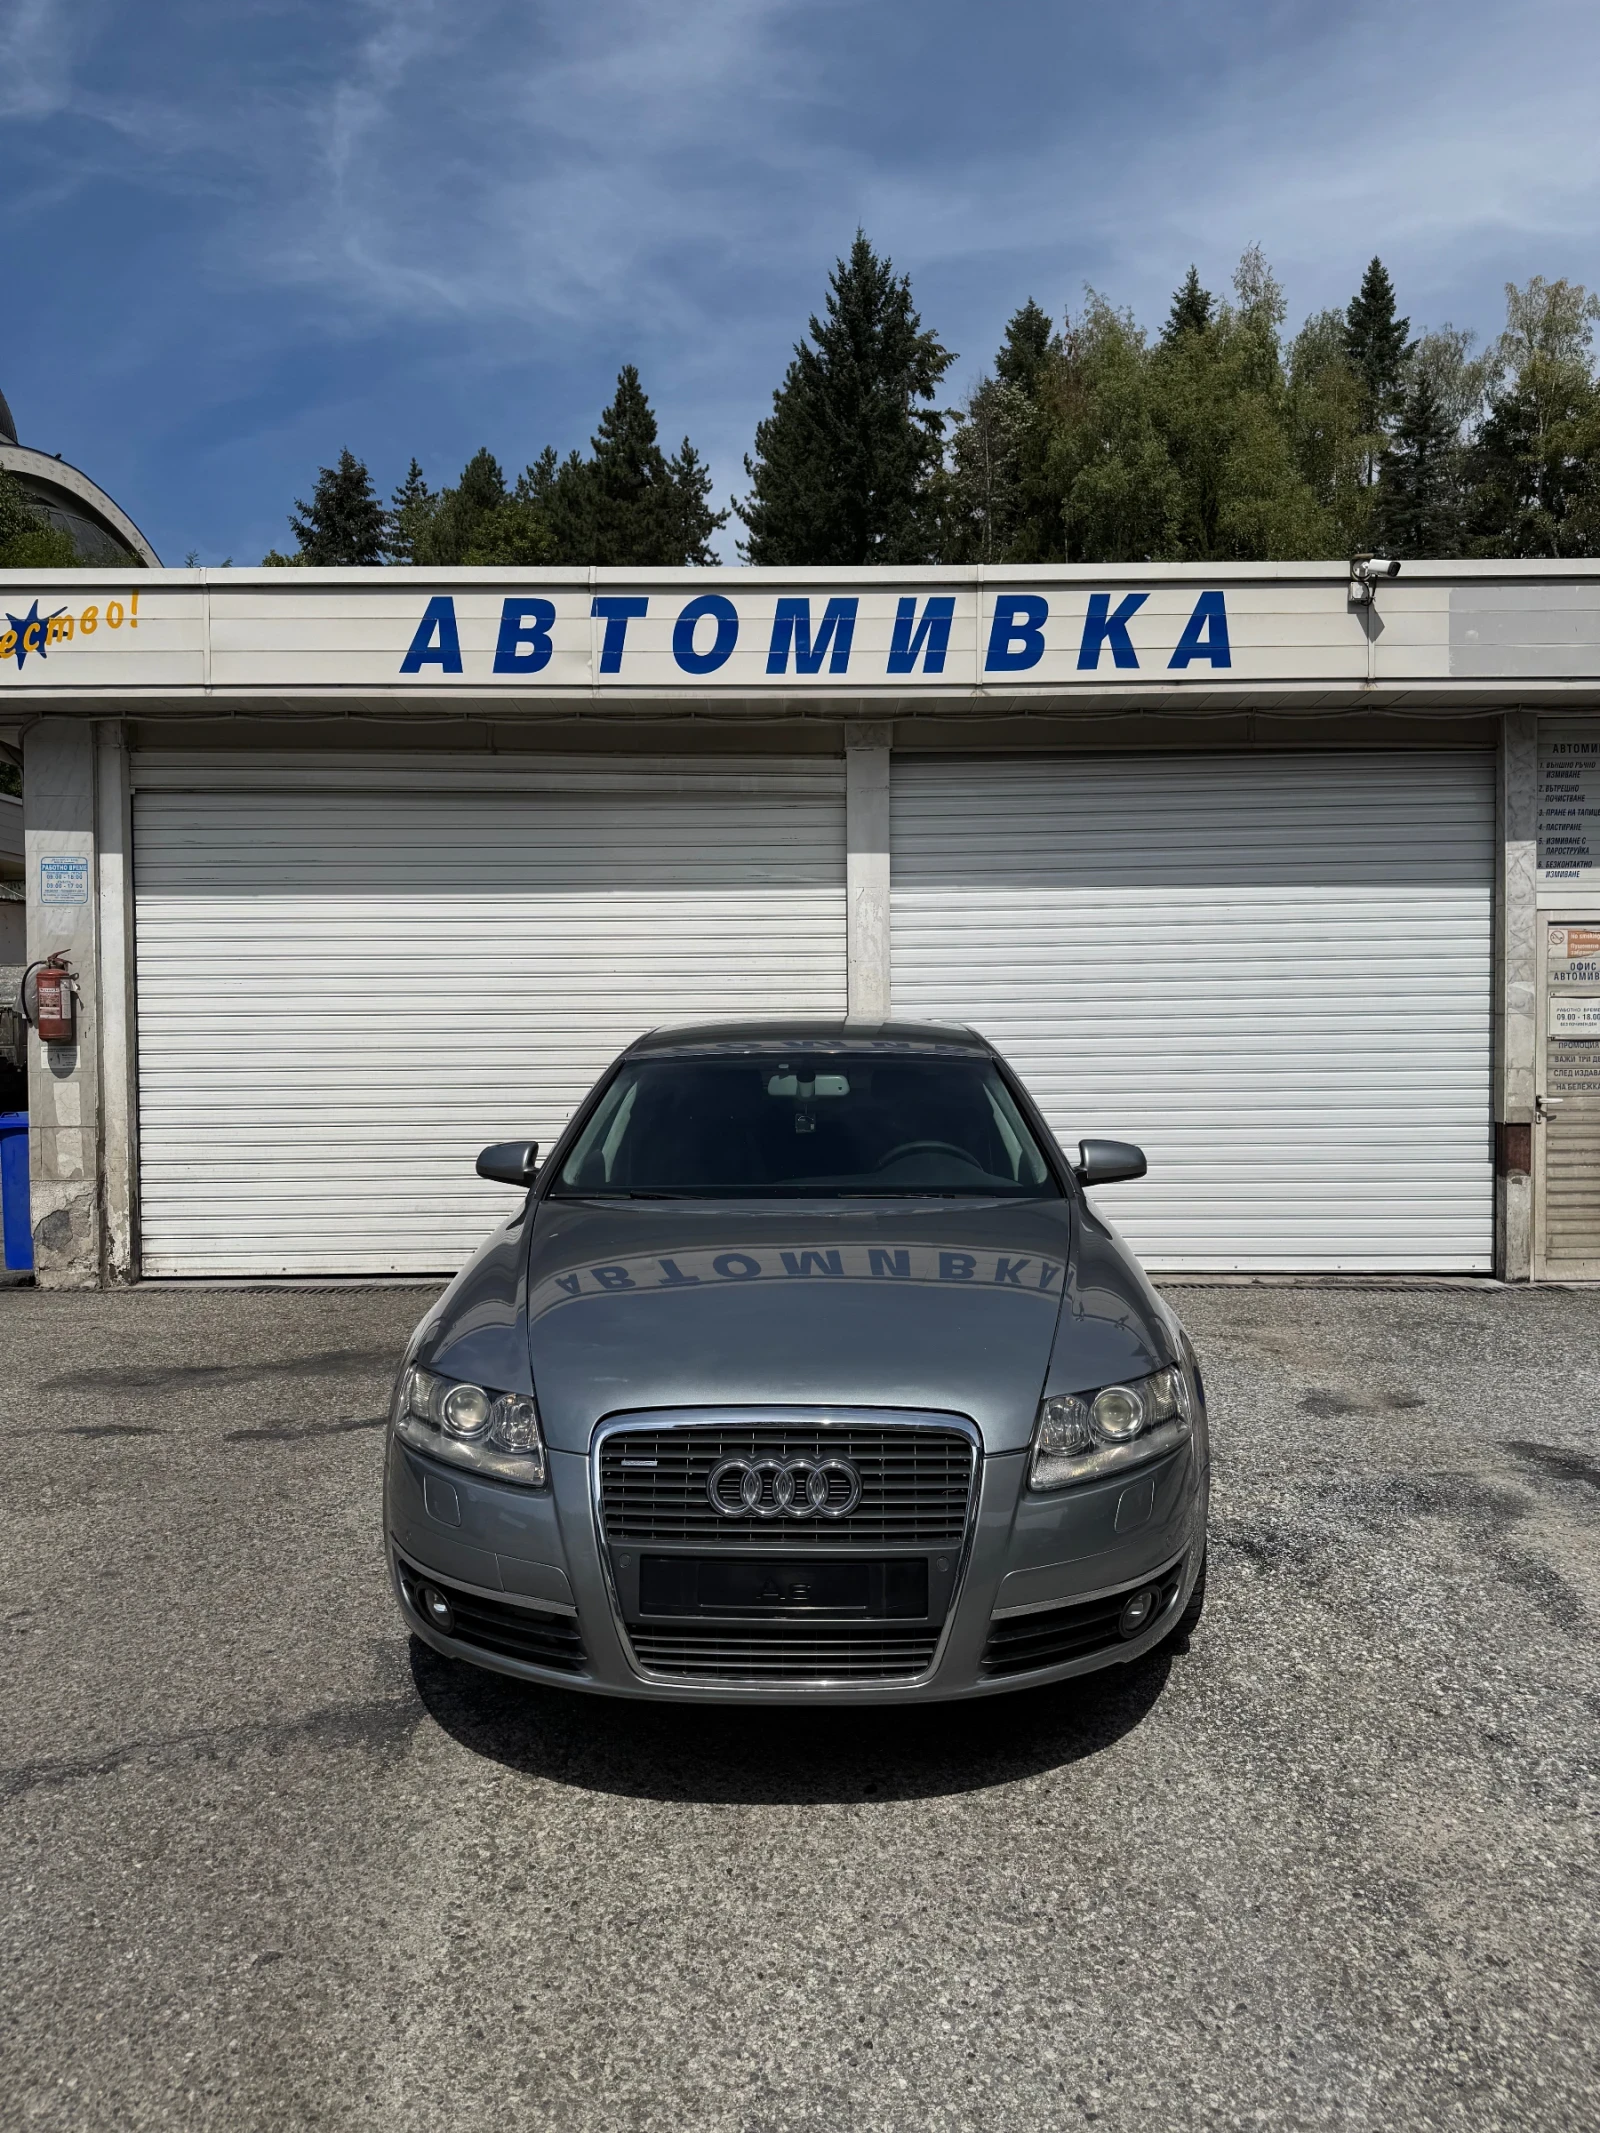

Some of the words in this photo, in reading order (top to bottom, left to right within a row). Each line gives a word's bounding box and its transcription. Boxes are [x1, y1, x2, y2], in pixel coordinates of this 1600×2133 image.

[399, 591, 1232, 675] АВТОМИВКА
[1546, 770, 1582, 779] ИЗМИВАНЕ
[1545, 784, 1580, 793] ВЪТРЕШНО
[1545, 794, 1586, 803] ПОЧИСТВАНЕ
[1545, 808, 1567, 817] ПРАНЕ
[1567, 808, 1576, 817] НА
[1545, 823, 1582, 831] ПАСТИРАНЕ
[1545, 837, 1581, 845] ИЗМИВАНЕ
[1581, 837, 1587, 845] С
[1545, 846, 1590, 855] ПАРОСТРУЙКА
[1545, 860, 1593, 869] БЕЗКОНТАКТНО
[1545, 870, 1581, 879] ИЗМИВАНЕ
[1570, 962, 1597, 971] ОФИС
[1553, 972, 1600, 981] АВТОМИВ
[1556, 1013, 1576, 1021] 09.00
[1558, 1041, 1600, 1049] ПРОМОЦИЯ
[1554, 1055, 1576, 1063] ВАЖИ
[1578, 1055, 1591, 1063] ТРИ
[1553, 1069, 1573, 1077] СЛЕД
[1556, 1083, 1566, 1091] НА
